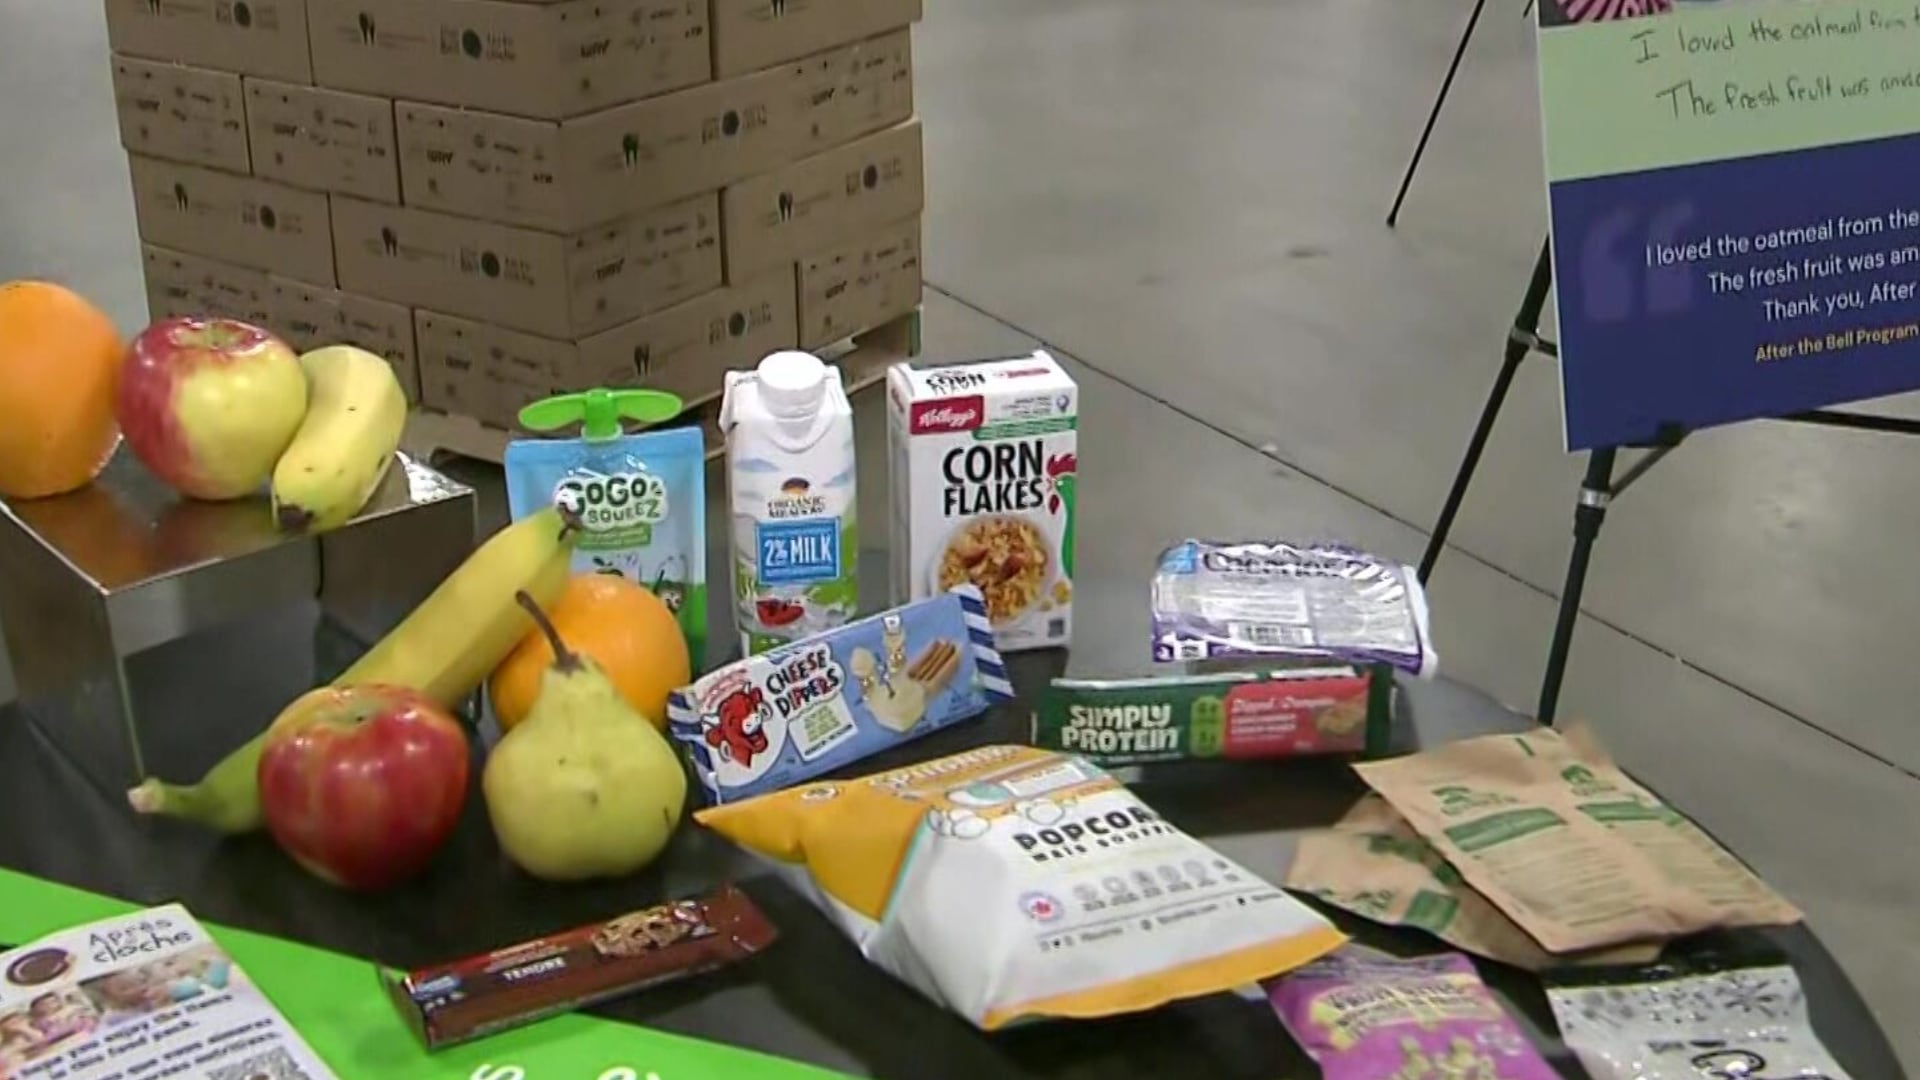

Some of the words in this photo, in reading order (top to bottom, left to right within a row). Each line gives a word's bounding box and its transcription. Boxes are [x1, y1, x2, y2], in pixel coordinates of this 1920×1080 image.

[1630, 29, 1660, 64] I
[1750, 18, 1782, 43] the
[1655, 79, 1716, 119] The
[1656, 235, 1712, 266] loved
[1716, 233, 1750, 257] the
[1753, 218, 1834, 251] oatmeal
[1837, 215, 1884, 239] from
[1888, 207, 1920, 230] the
[1707, 271, 1745, 294] The
[1749, 260, 1799, 290] fresh
[1802, 255, 1843, 281] fruit
[1847, 254, 1886, 272] was
[1763, 293, 1821, 323] Thank
[1825, 289, 1865, 317] you,
[1868, 279, 1918, 306] After
[1754, 343, 1796, 364] After
[1797, 334, 1824, 356] the
[1825, 329, 1854, 352] Bell
[1855, 321, 1920, 348] Program
[942, 440, 1044, 485] CORN
[943, 477, 1044, 518] FLAKES
[790, 533, 833, 564] MILK
[765, 649, 827, 695] CHEESE
[775, 667, 840, 719] DIPPERS
[1069, 703, 1172, 730] SIMPLY
